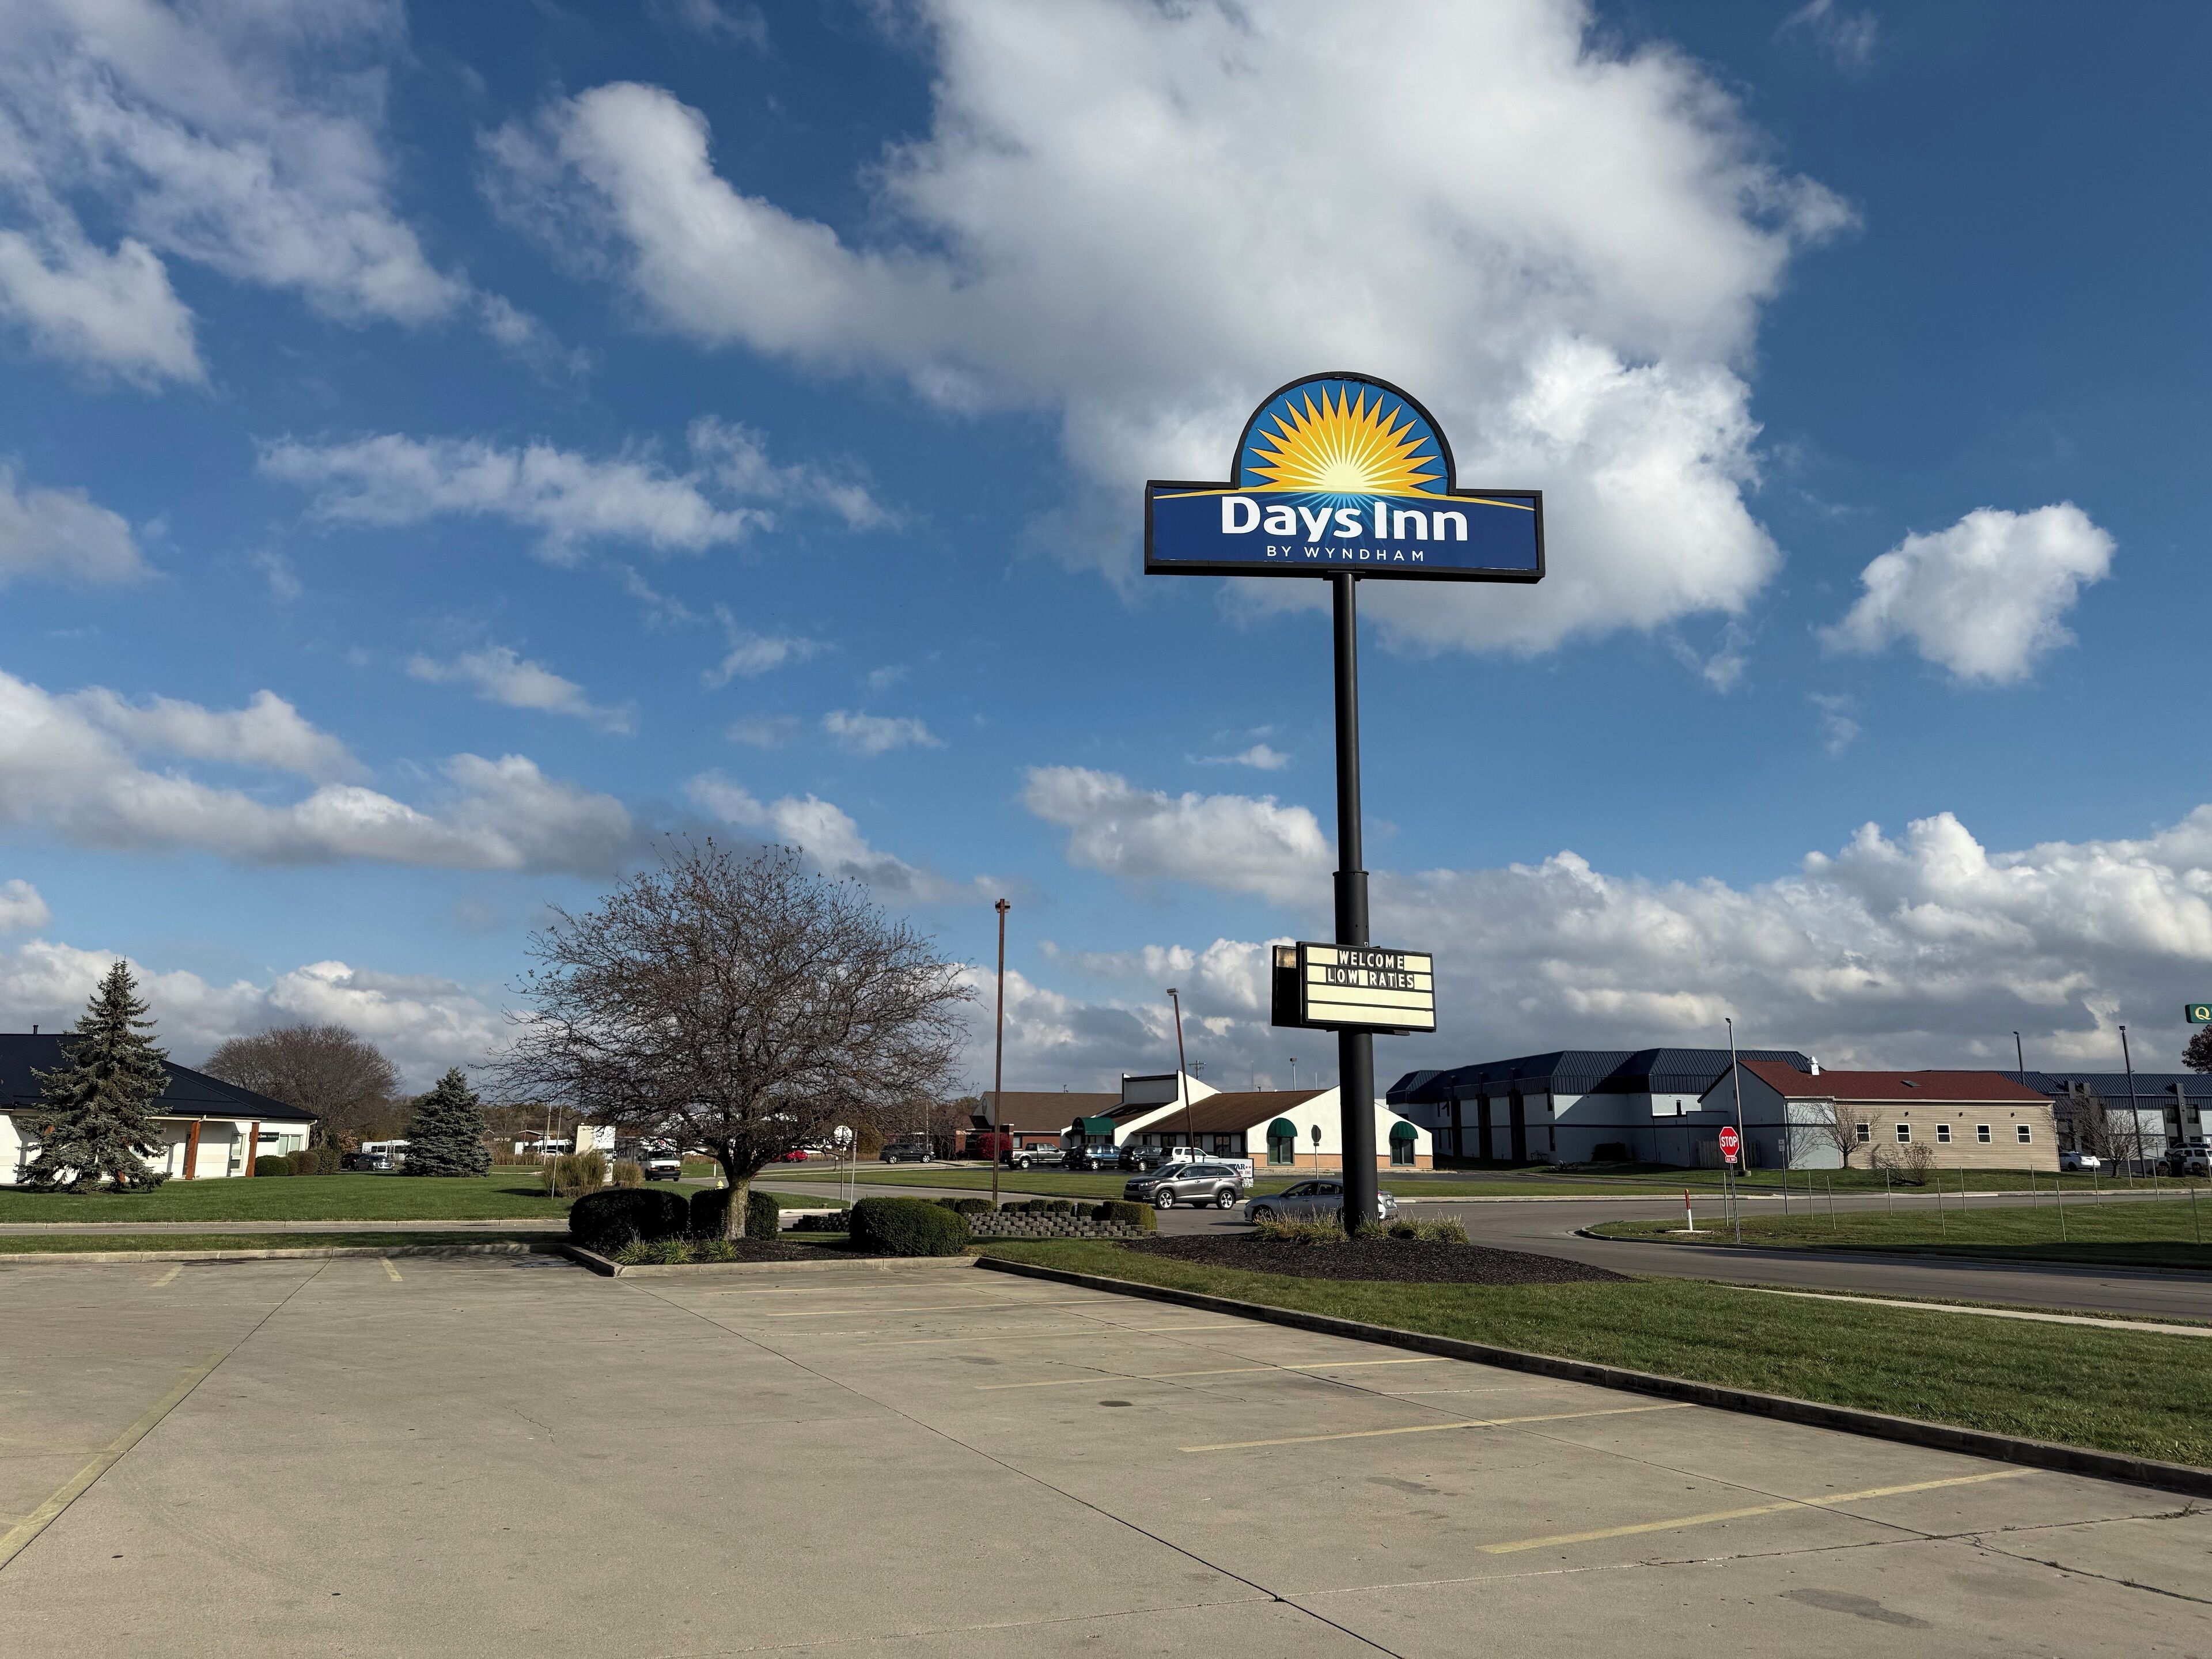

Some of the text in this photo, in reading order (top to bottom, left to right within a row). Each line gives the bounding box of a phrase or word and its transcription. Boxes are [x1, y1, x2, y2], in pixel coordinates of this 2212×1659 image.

[1222, 496, 1468, 542] Days Inn
[1267, 546, 1424, 562] BY WYNDHAM
[1339, 950, 1404, 969] WELCOME
[1328, 968, 1414, 988] LOW RATES
[1721, 1136, 1737, 1147] STOP
